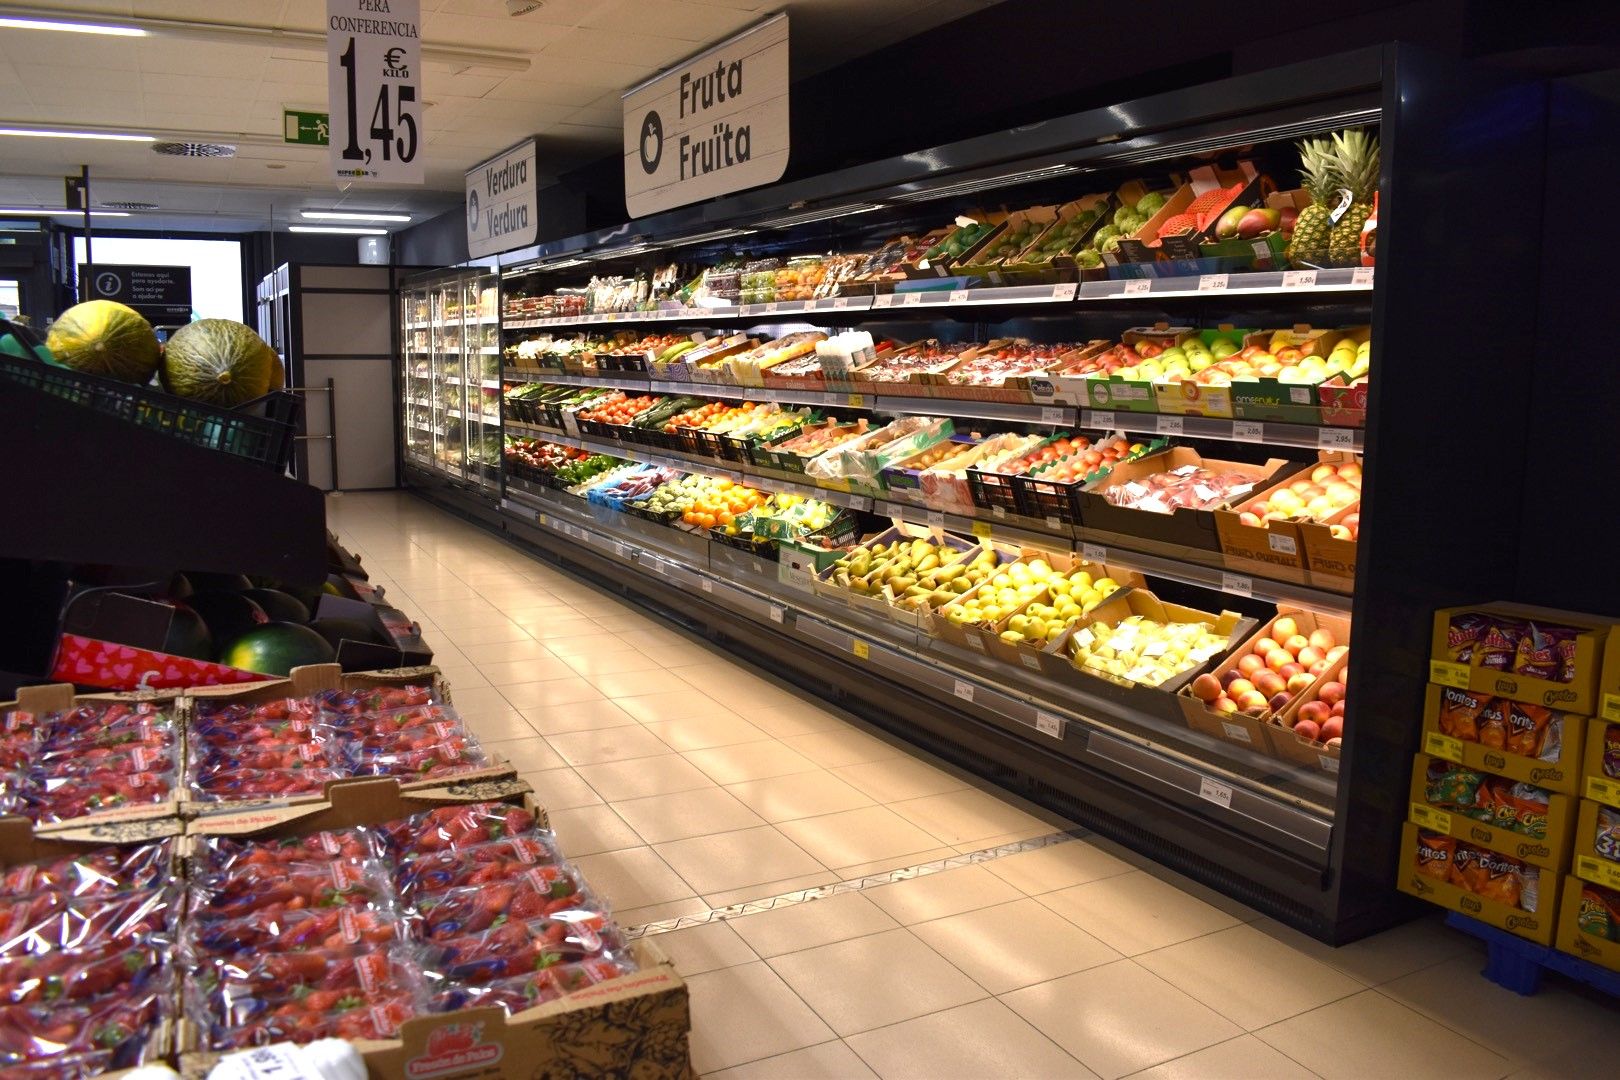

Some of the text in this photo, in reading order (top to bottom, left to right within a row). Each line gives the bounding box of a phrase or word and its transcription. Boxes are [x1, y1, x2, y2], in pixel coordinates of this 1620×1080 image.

[358, 0, 391, 13] PERA
[330, 15, 419, 39] CONFERENCIA
[383, 68, 410, 79] KILO
[680, 60, 743, 119] Fruta
[680, 122, 751, 181] Fruïta
[486, 160, 528, 198] Verdura
[487, 202, 529, 238] Verdura
